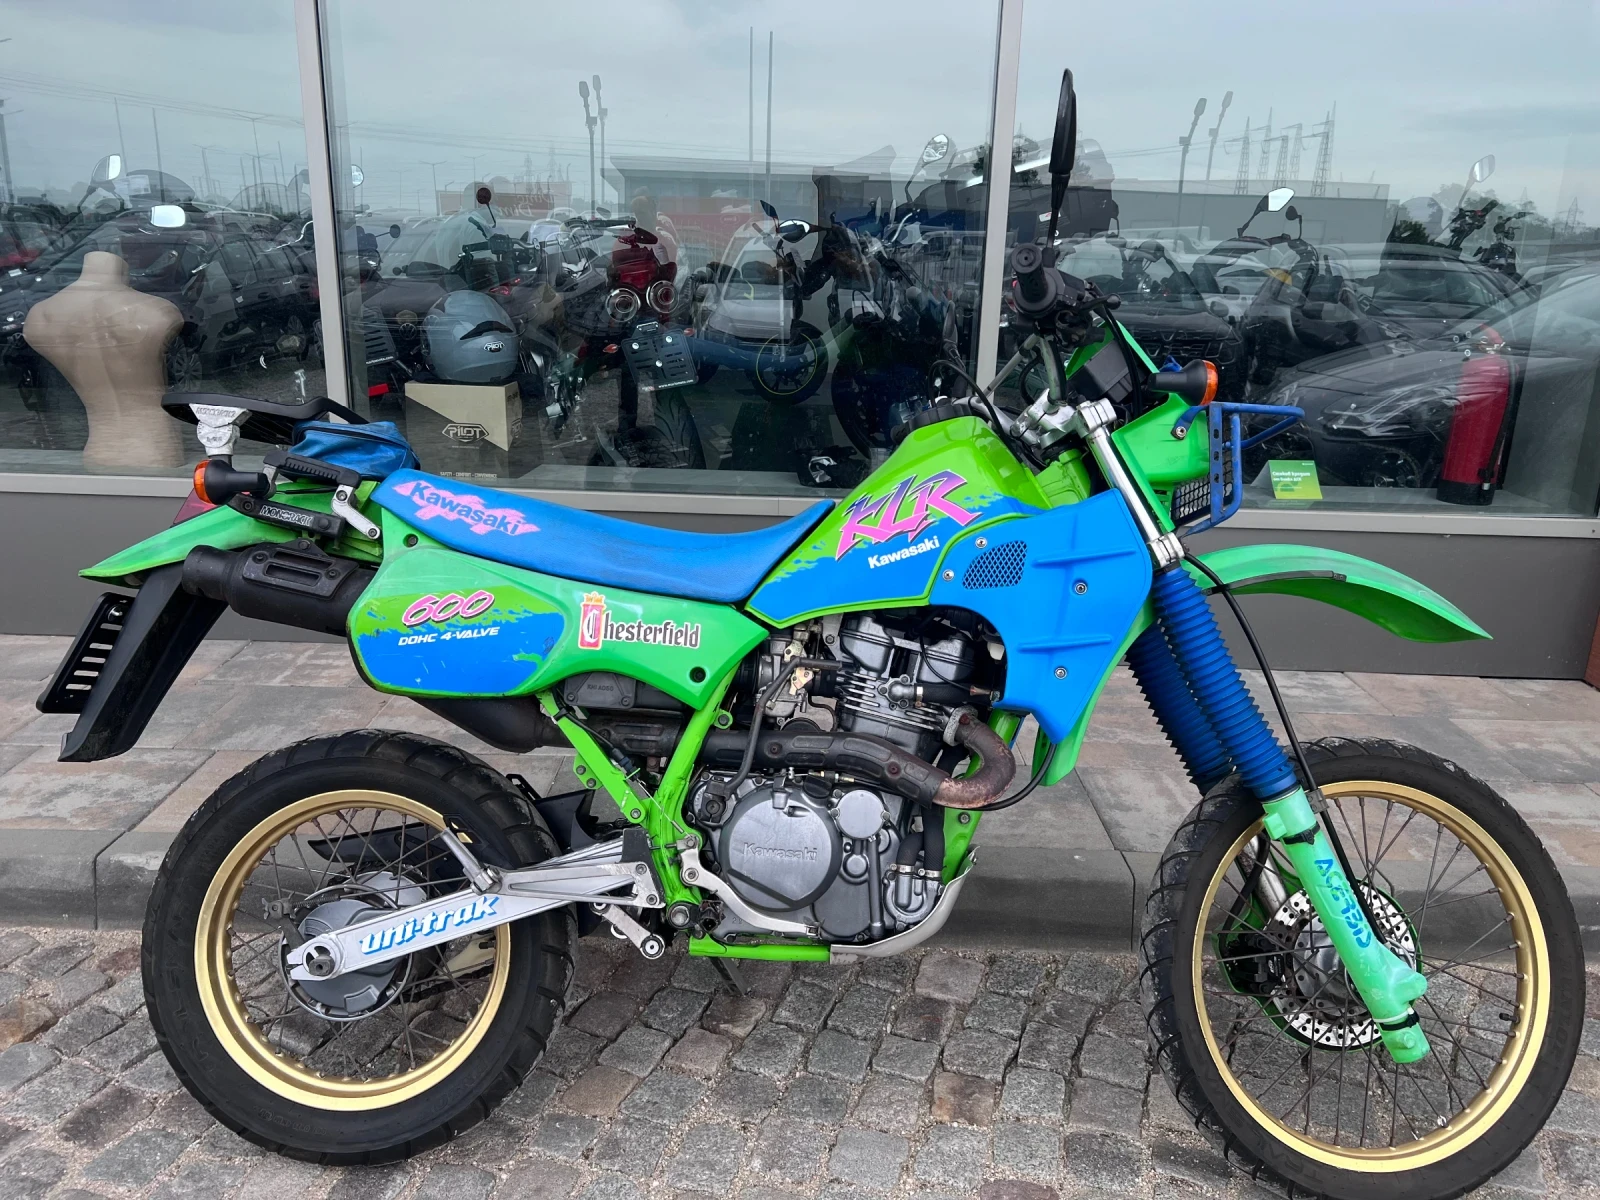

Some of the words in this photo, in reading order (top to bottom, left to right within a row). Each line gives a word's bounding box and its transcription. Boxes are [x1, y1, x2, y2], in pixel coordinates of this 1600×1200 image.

[409, 482, 523, 536] Kawasaki
[835, 469, 983, 561] KLR
[868, 536, 940, 569] Kawasaki
[402, 590, 495, 628] 600
[398, 633, 438, 646] DOHC
[440, 626, 500, 641] 4-VALVE
[582, 609, 700, 648] Chesterfield
[743, 842, 818, 862] Kawasaki
[359, 896, 499, 955] uni-trak
